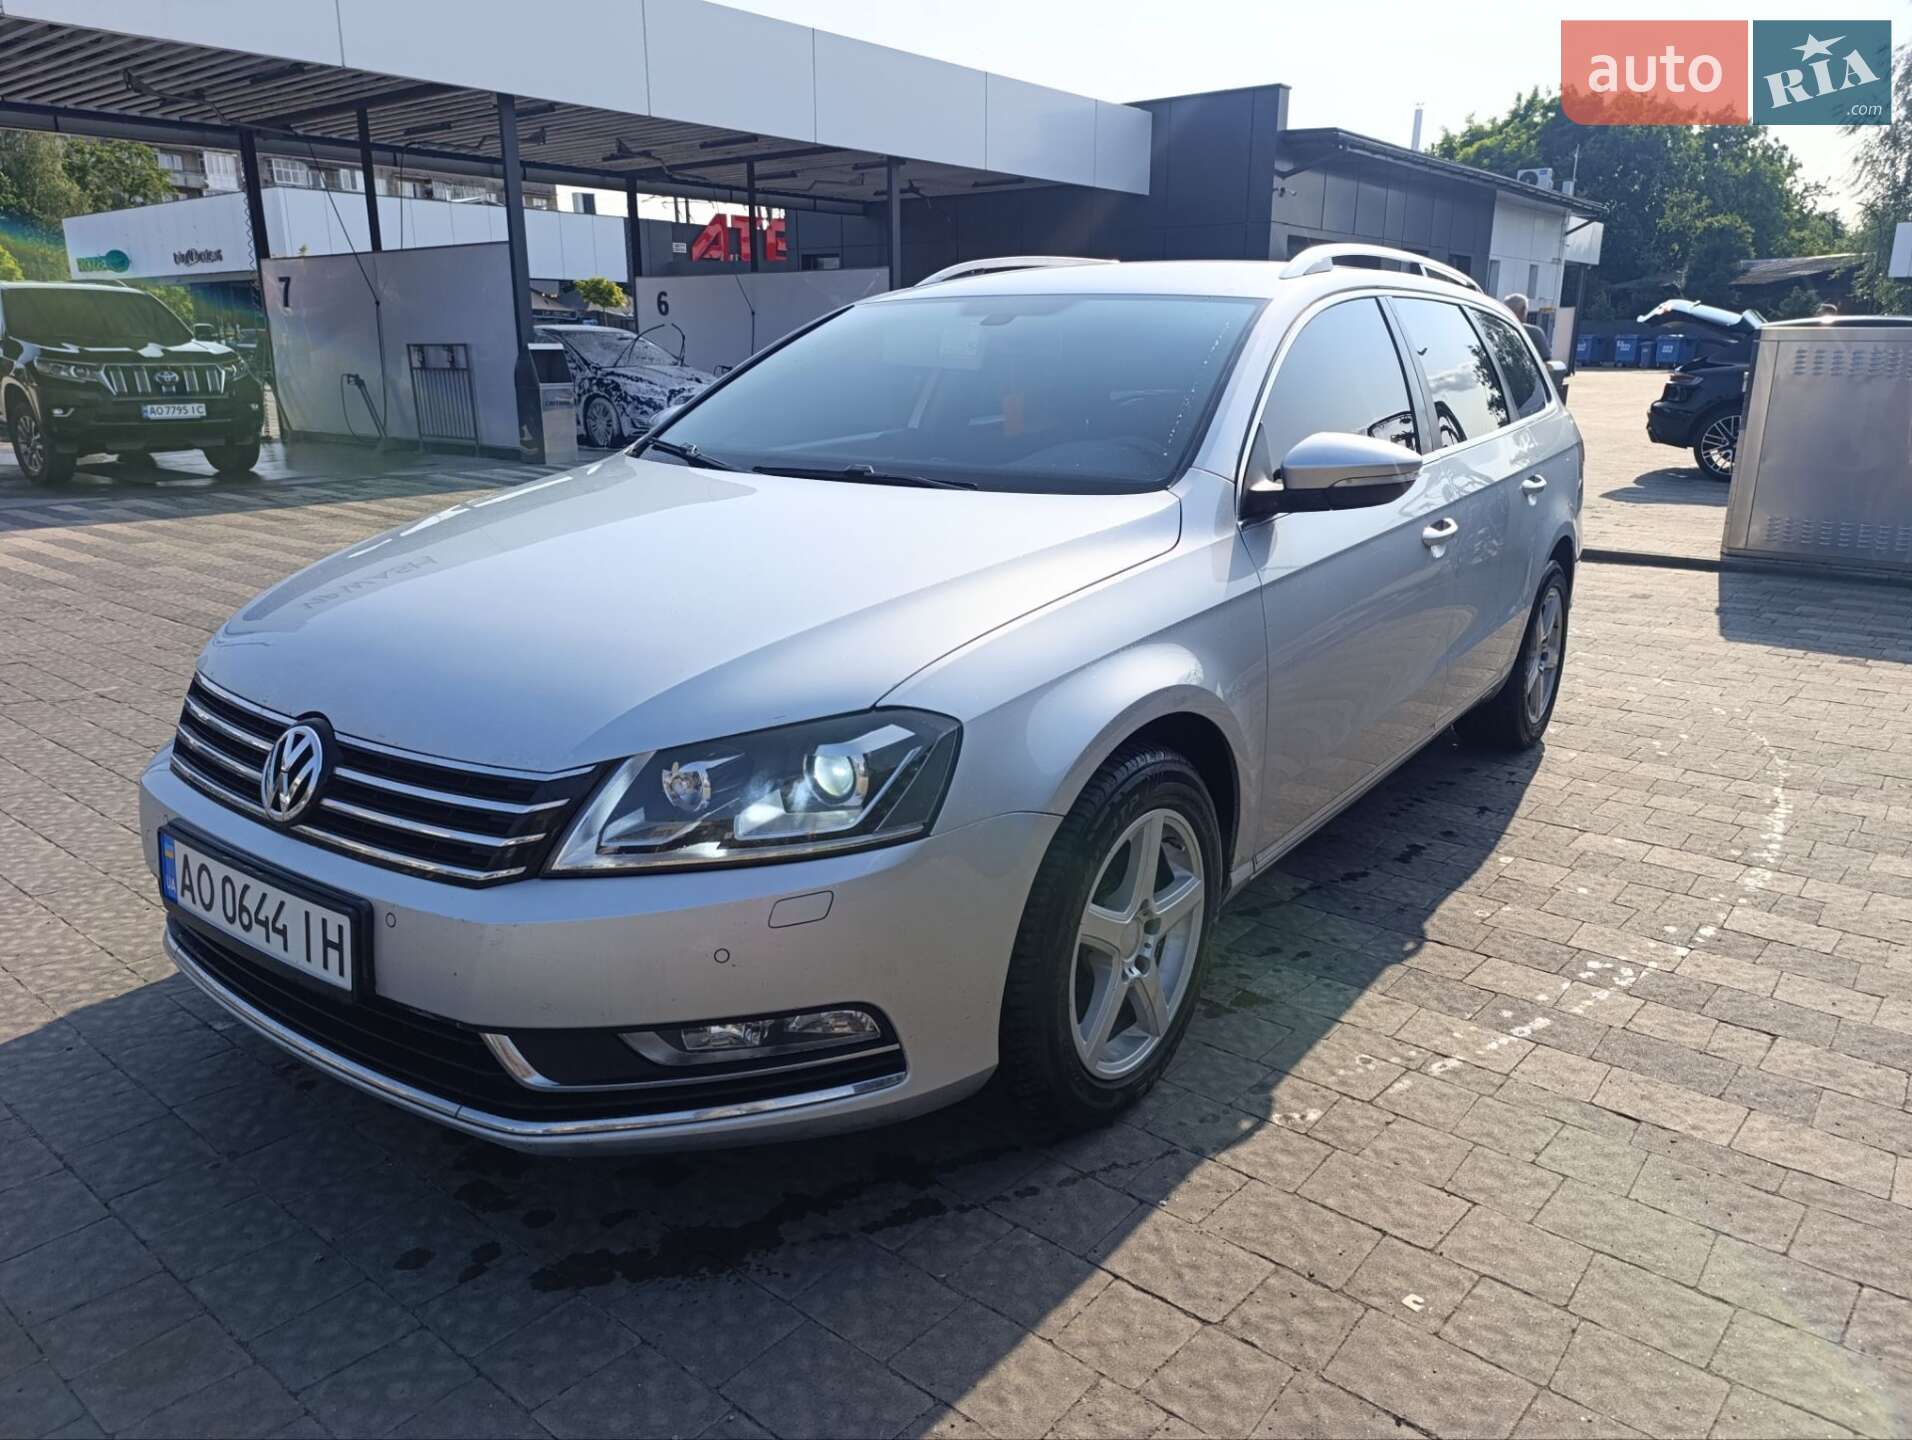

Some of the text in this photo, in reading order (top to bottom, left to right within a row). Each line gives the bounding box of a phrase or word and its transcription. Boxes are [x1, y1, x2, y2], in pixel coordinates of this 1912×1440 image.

[277, 276, 291, 308] 7
[656, 290, 670, 316] 6
[149, 406, 164, 416] AO
[165, 406, 189, 416] 7795
[180, 853, 345, 977] AO 0644 IH
